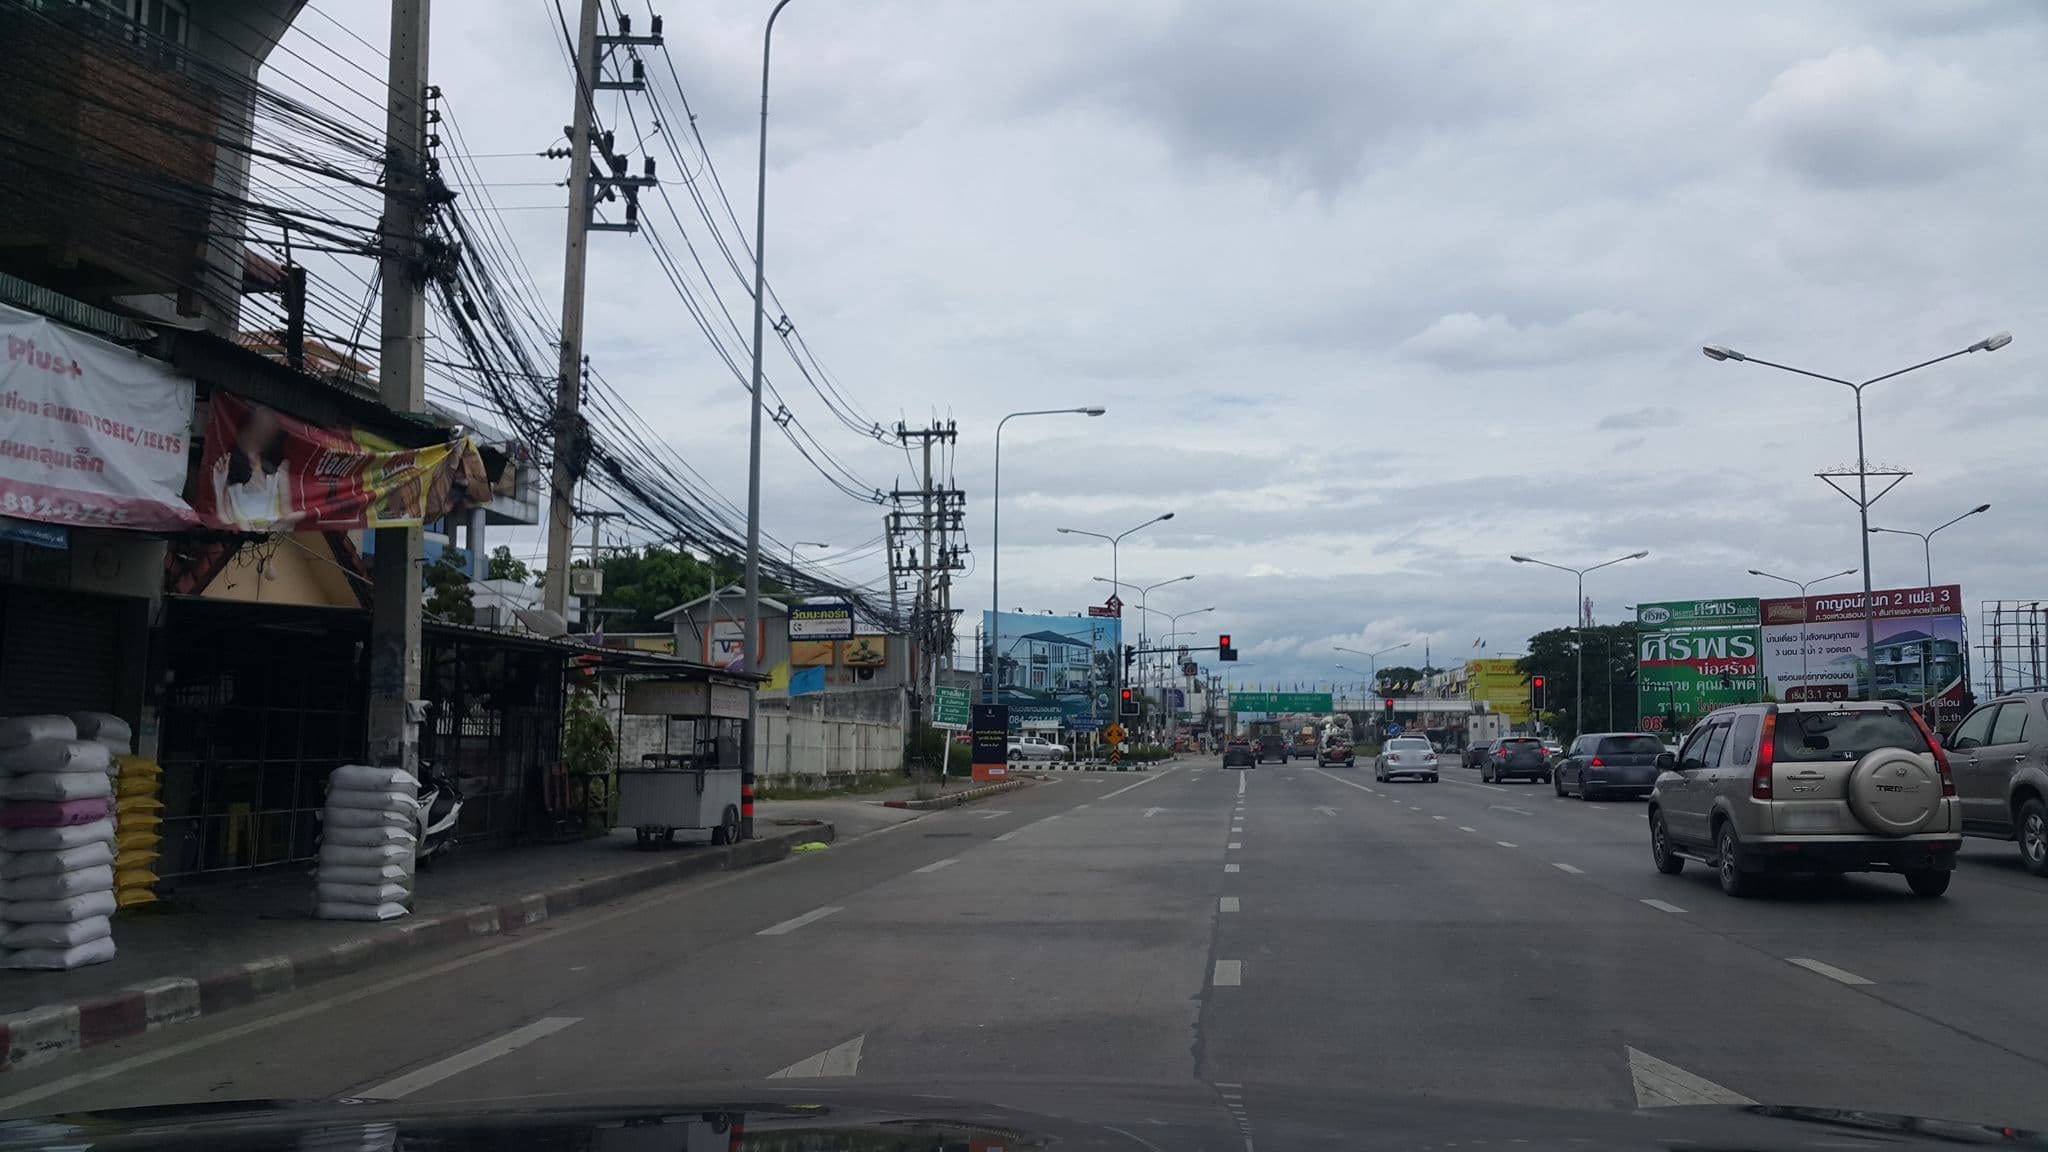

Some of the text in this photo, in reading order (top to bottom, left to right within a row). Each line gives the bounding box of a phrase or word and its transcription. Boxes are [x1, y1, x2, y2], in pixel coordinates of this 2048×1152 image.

[0, 390, 38, 415] tion
[95, 416, 181, 454] TOEIC/IELTS
[1894, 594, 1903, 604] 2
[1909, 591, 1934, 604] เฟส
[1941, 590, 1950, 601] 3
[1816, 605, 1950, 621] ถ.วงแหวนรอบนก สันกำแพง-ดอยะเก็ด
[1641, 632, 1755, 661] ศิริพร
[1697, 662, 1755, 675] บ่อสร้าง
[1807, 689, 1822, 699] 3.1
